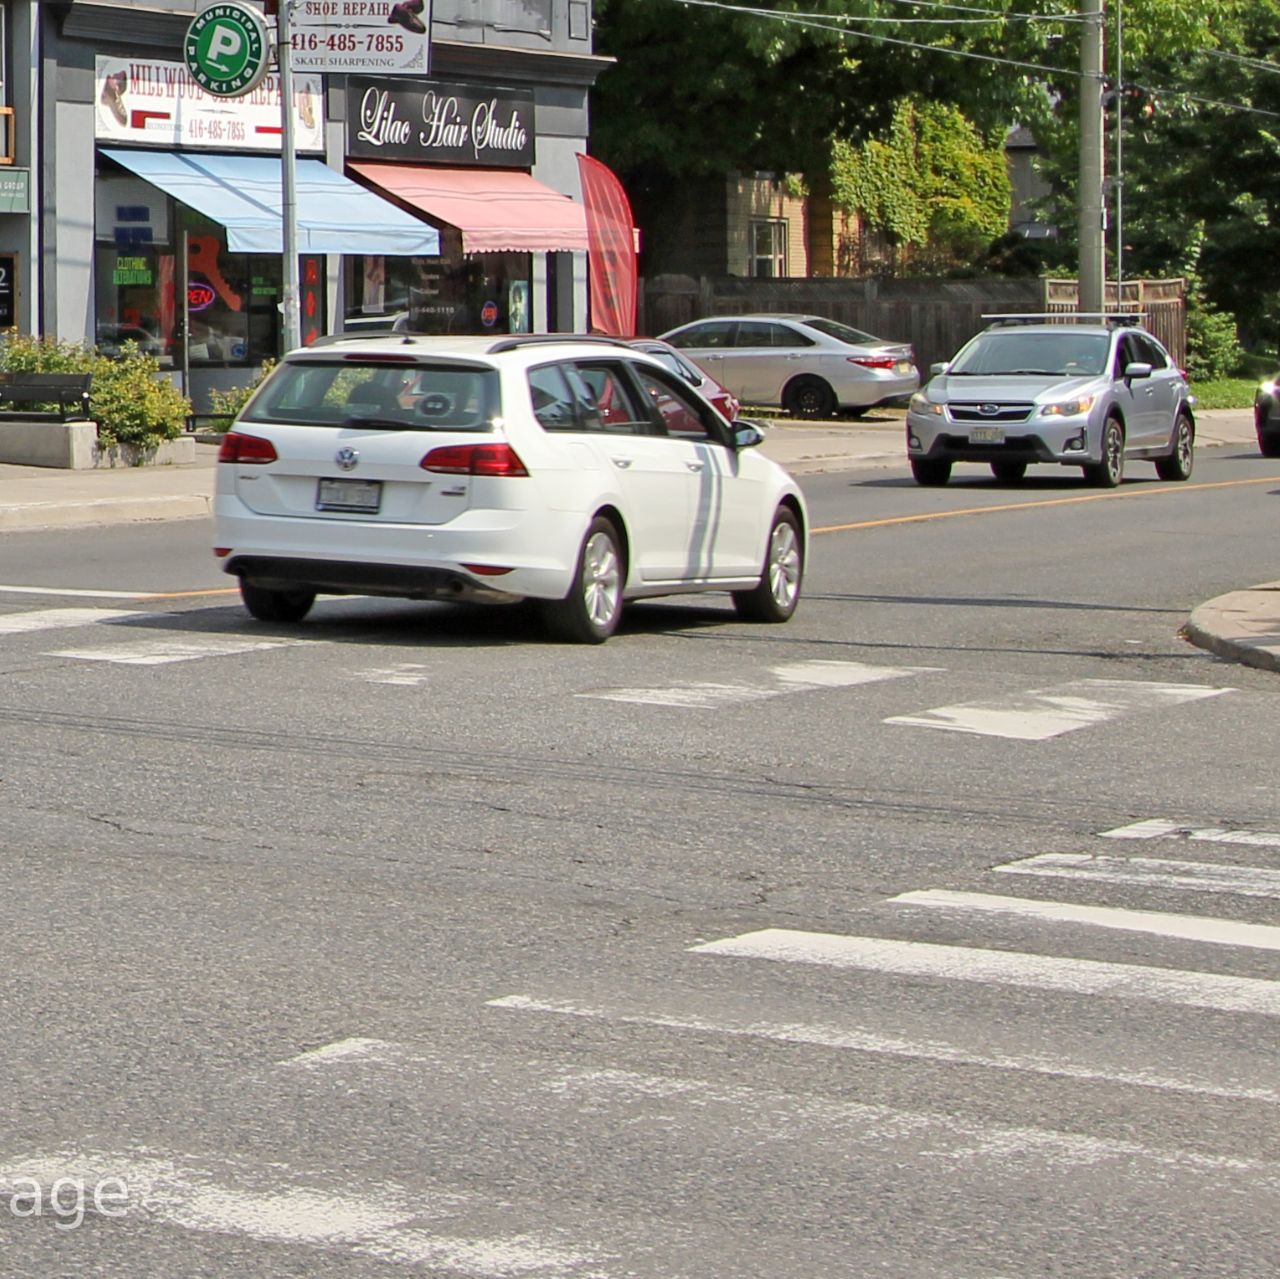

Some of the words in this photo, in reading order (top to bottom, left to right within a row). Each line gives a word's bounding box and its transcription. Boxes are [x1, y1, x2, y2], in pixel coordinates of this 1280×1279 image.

[305, 0, 338, 16] SHOE
[343, 0, 390, 16] REPAIR
[195, 8, 260, 53] MUNICIPAL
[207, 23, 240, 62] P
[291, 32, 404, 53] 416-485-7855
[187, 46, 253, 91] PARKING
[295, 56, 326, 66] SKATE
[328, 56, 395, 68] SHARPENING
[188, 117, 246, 141] 416-485-7855
[357, 86, 411, 146] Lilac
[419, 90, 468, 148] Hair
[471, 98, 528, 160] Studio
[186, 287, 211, 304] PEN
